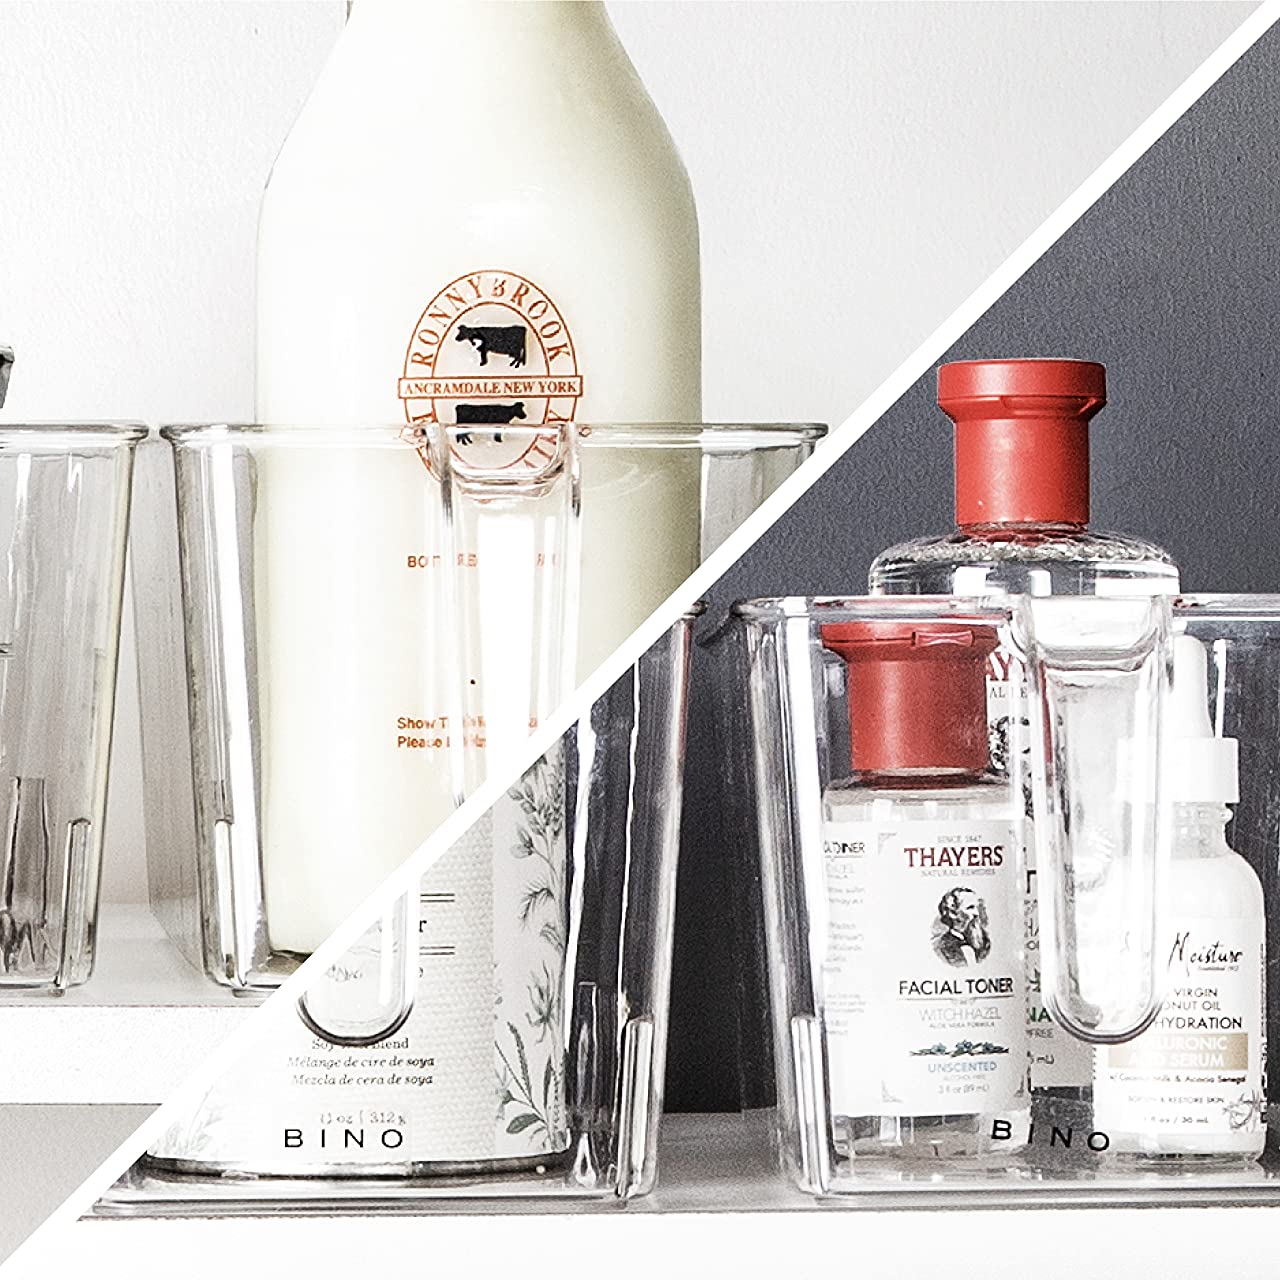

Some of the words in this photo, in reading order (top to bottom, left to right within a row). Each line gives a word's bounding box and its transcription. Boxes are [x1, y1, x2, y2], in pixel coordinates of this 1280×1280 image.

[410, 275, 571, 368] RONNYBROOK
[404, 382, 501, 395] ANCRAMDALE
[503, 381, 537, 394] NEW
[538, 380, 578, 394] YORK
[397, 717, 436, 729] Show
[903, 846, 1005, 868] THAYERS
[898, 980, 963, 995] FACIAL
[964, 977, 1014, 994] TONER
[1173, 987, 1219, 998] VIRGIN
[1201, 1000, 1222, 1011] OIL
[920, 1007, 963, 1021] WITCH
[1154, 1016, 1243, 1029] HYDRATION
[343, 1056, 359, 1068] de
[388, 1055, 403, 1067] de
[406, 1057, 435, 1069] soya
[927, 1061, 998, 1073] UNSCENTED
[1172, 1053, 1225, 1067] SERUM
[338, 1074, 354, 1086] de
[387, 1073, 402, 1085] de
[405, 1074, 433, 1087] soya
[369, 1111, 396, 1124] 312
[283, 1128, 405, 1149] BINO
[991, 1119, 1110, 1151] BINO
